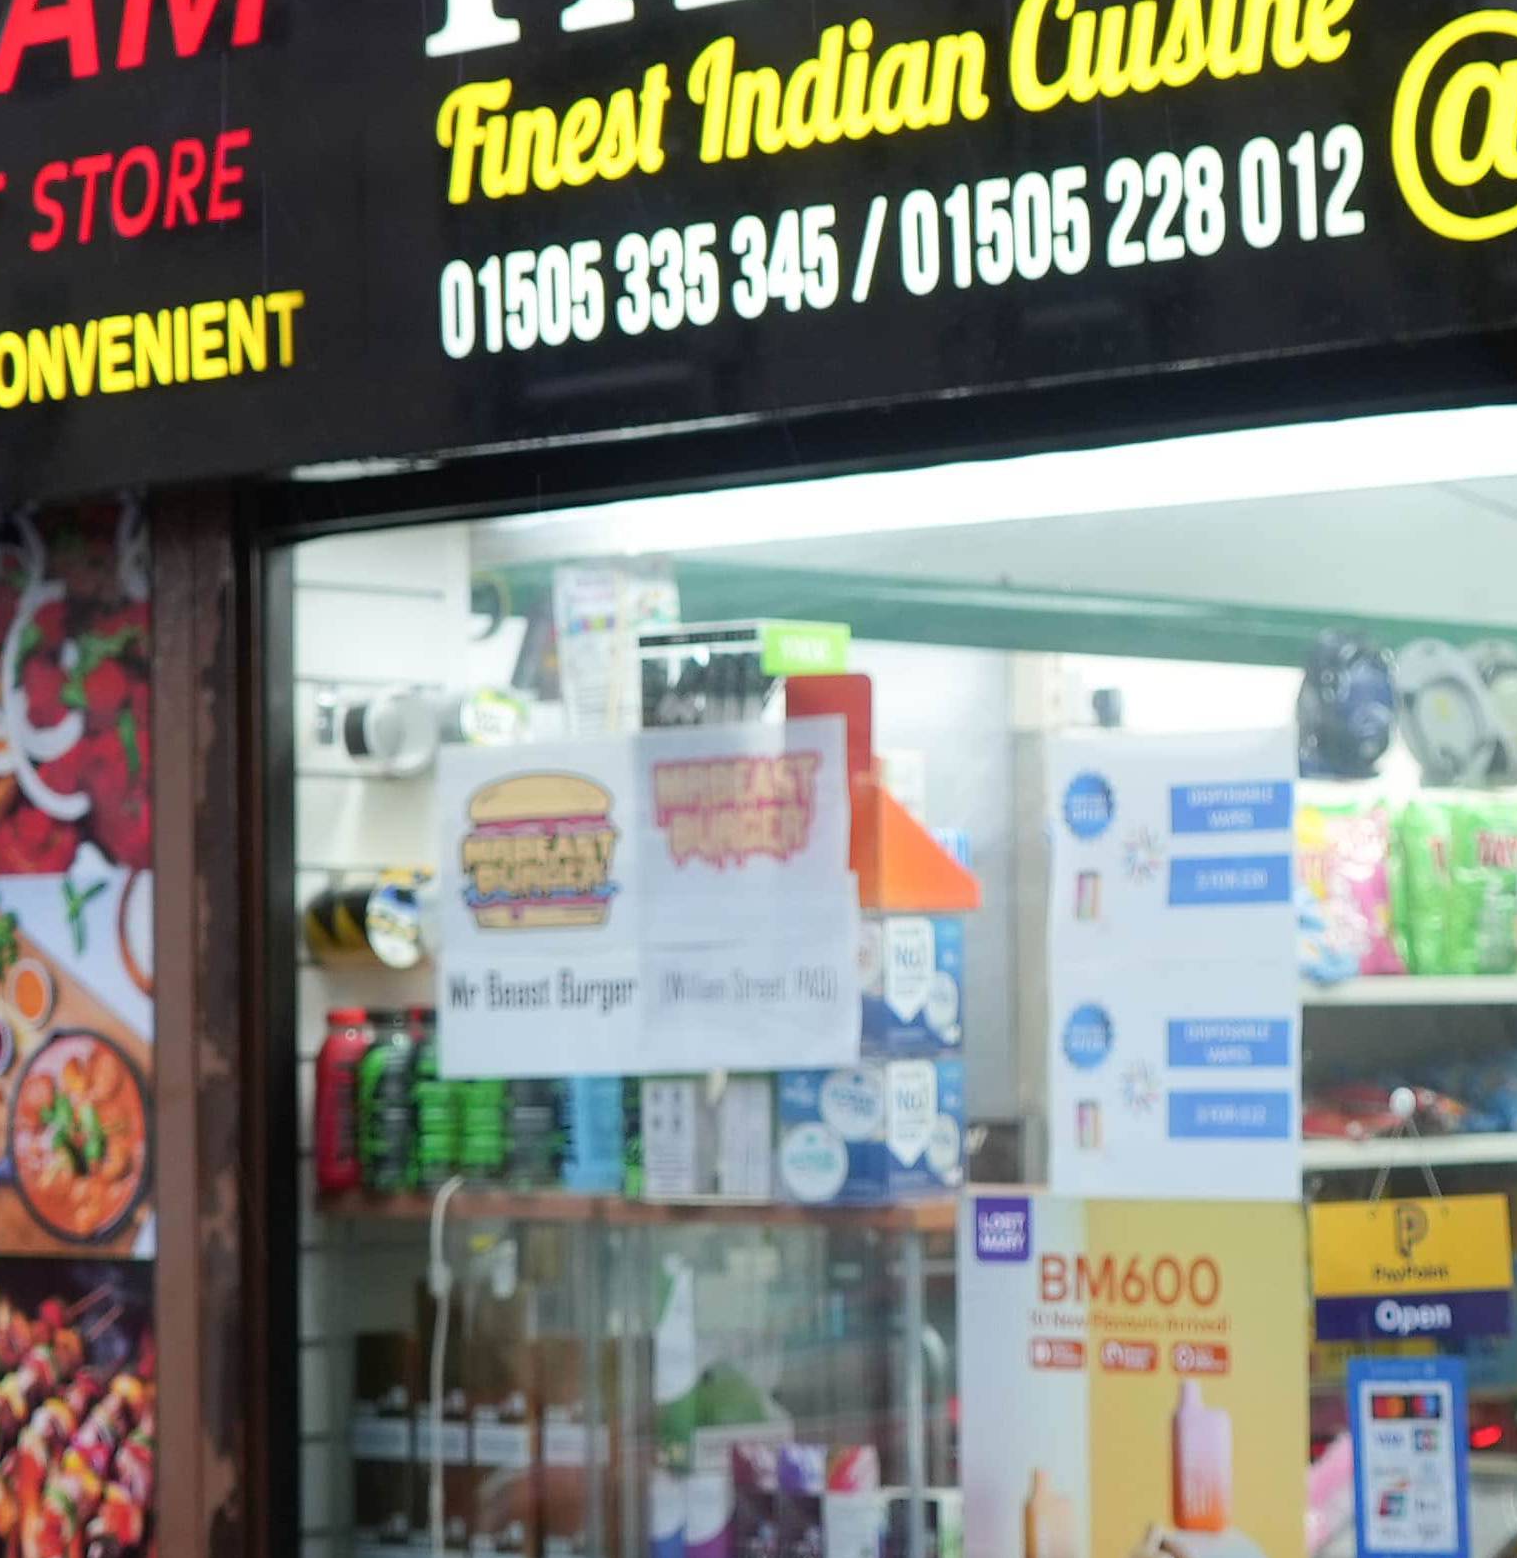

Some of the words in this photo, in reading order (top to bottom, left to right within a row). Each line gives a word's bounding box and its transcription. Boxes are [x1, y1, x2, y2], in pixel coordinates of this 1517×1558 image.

[436, 63, 671, 204] Finest
[689, 18, 989, 163] Indian
[30, 128, 252, 251] STORE
[440, 240, 605, 358] 01505
[616, 223, 720, 335] 335
[730, 204, 839, 319] 345
[852, 196, 887, 303] /
[900, 166, 1090, 295] 01505
[1104, 145, 1225, 267] 228
[1239, 124, 1365, 248] 012
[487, 968, 551, 1011] Beast
[559, 966, 639, 1017] Burger
[1041, 1255, 1220, 1306] BM600
[1372, 1265, 1449, 1282] PayPoint
[1375, 1299, 1452, 1335] Open
